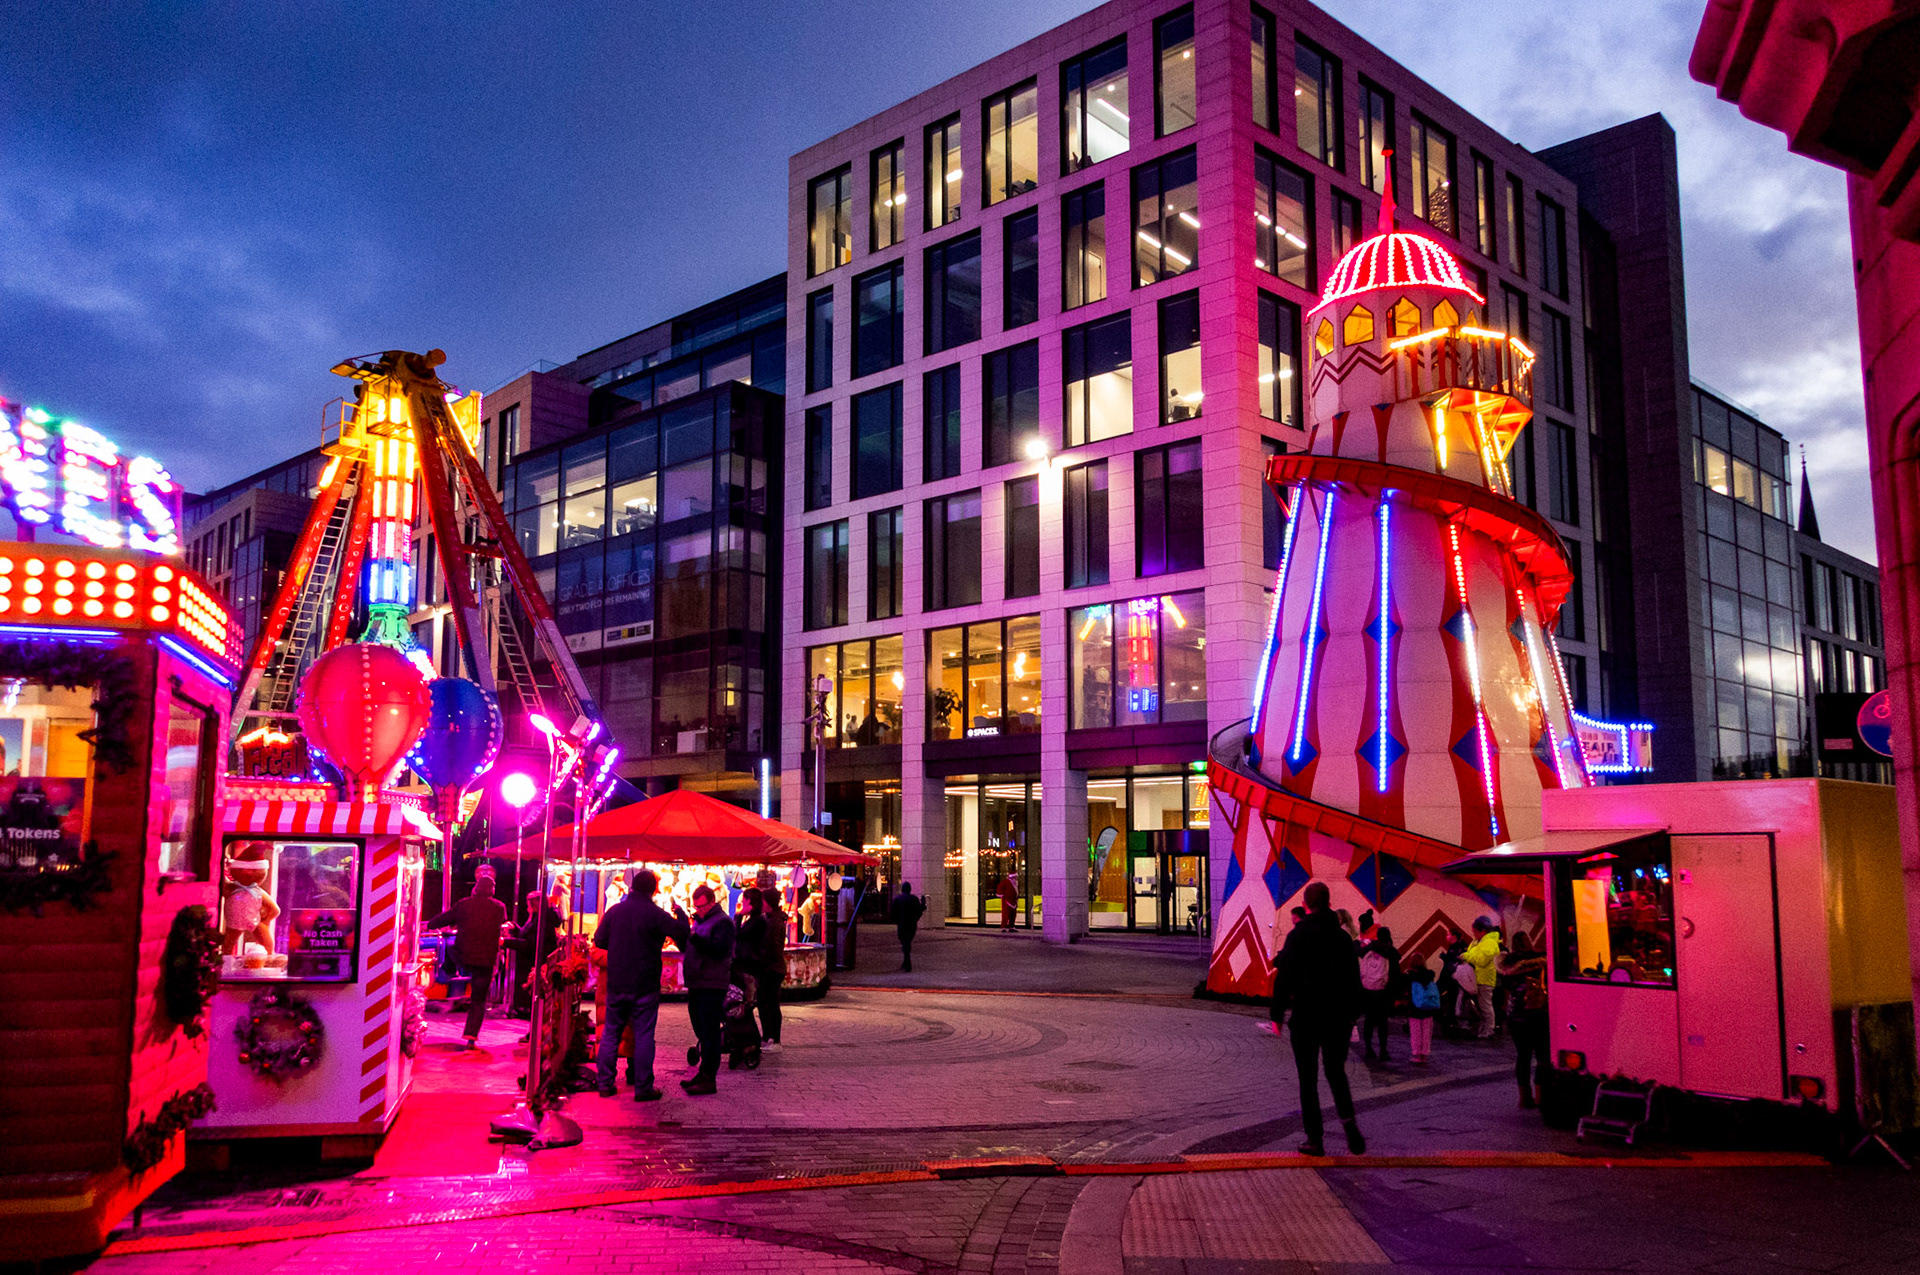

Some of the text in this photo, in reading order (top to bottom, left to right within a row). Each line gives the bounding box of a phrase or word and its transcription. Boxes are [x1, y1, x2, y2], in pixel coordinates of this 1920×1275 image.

[607, 568, 650, 591] OFFICES
[7, 827, 61, 839] Tokens
[303, 930, 343, 938] No Cash
[310, 939, 338, 947] Taken
